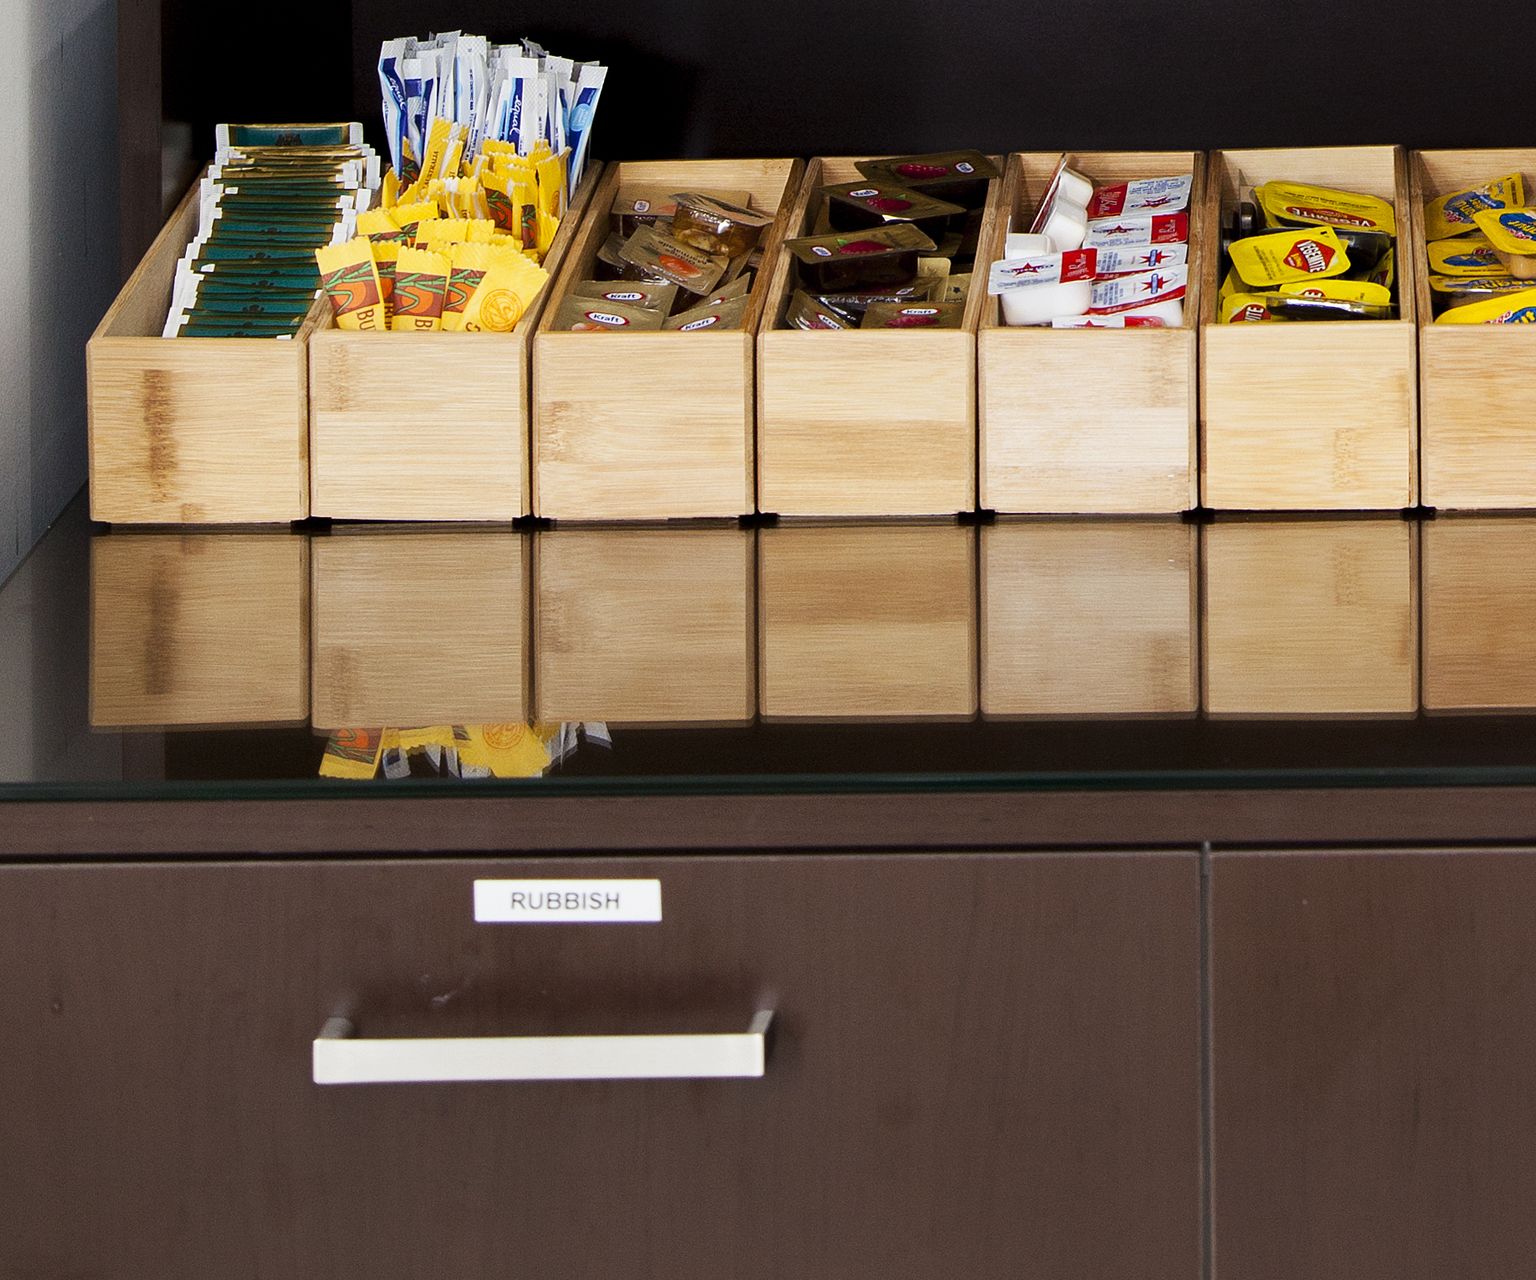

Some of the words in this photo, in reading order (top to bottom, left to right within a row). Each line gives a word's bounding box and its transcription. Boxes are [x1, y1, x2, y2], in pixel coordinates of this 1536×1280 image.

[389, 77, 406, 111] equal
[509, 95, 522, 135] equal
[1292, 208, 1372, 228] VEGEMITE
[1297, 241, 1326, 273] VEGEMITE
[593, 314, 619, 323] Kraft
[685, 319, 711, 331] Kraft
[511, 892, 620, 910] RUBBISH
